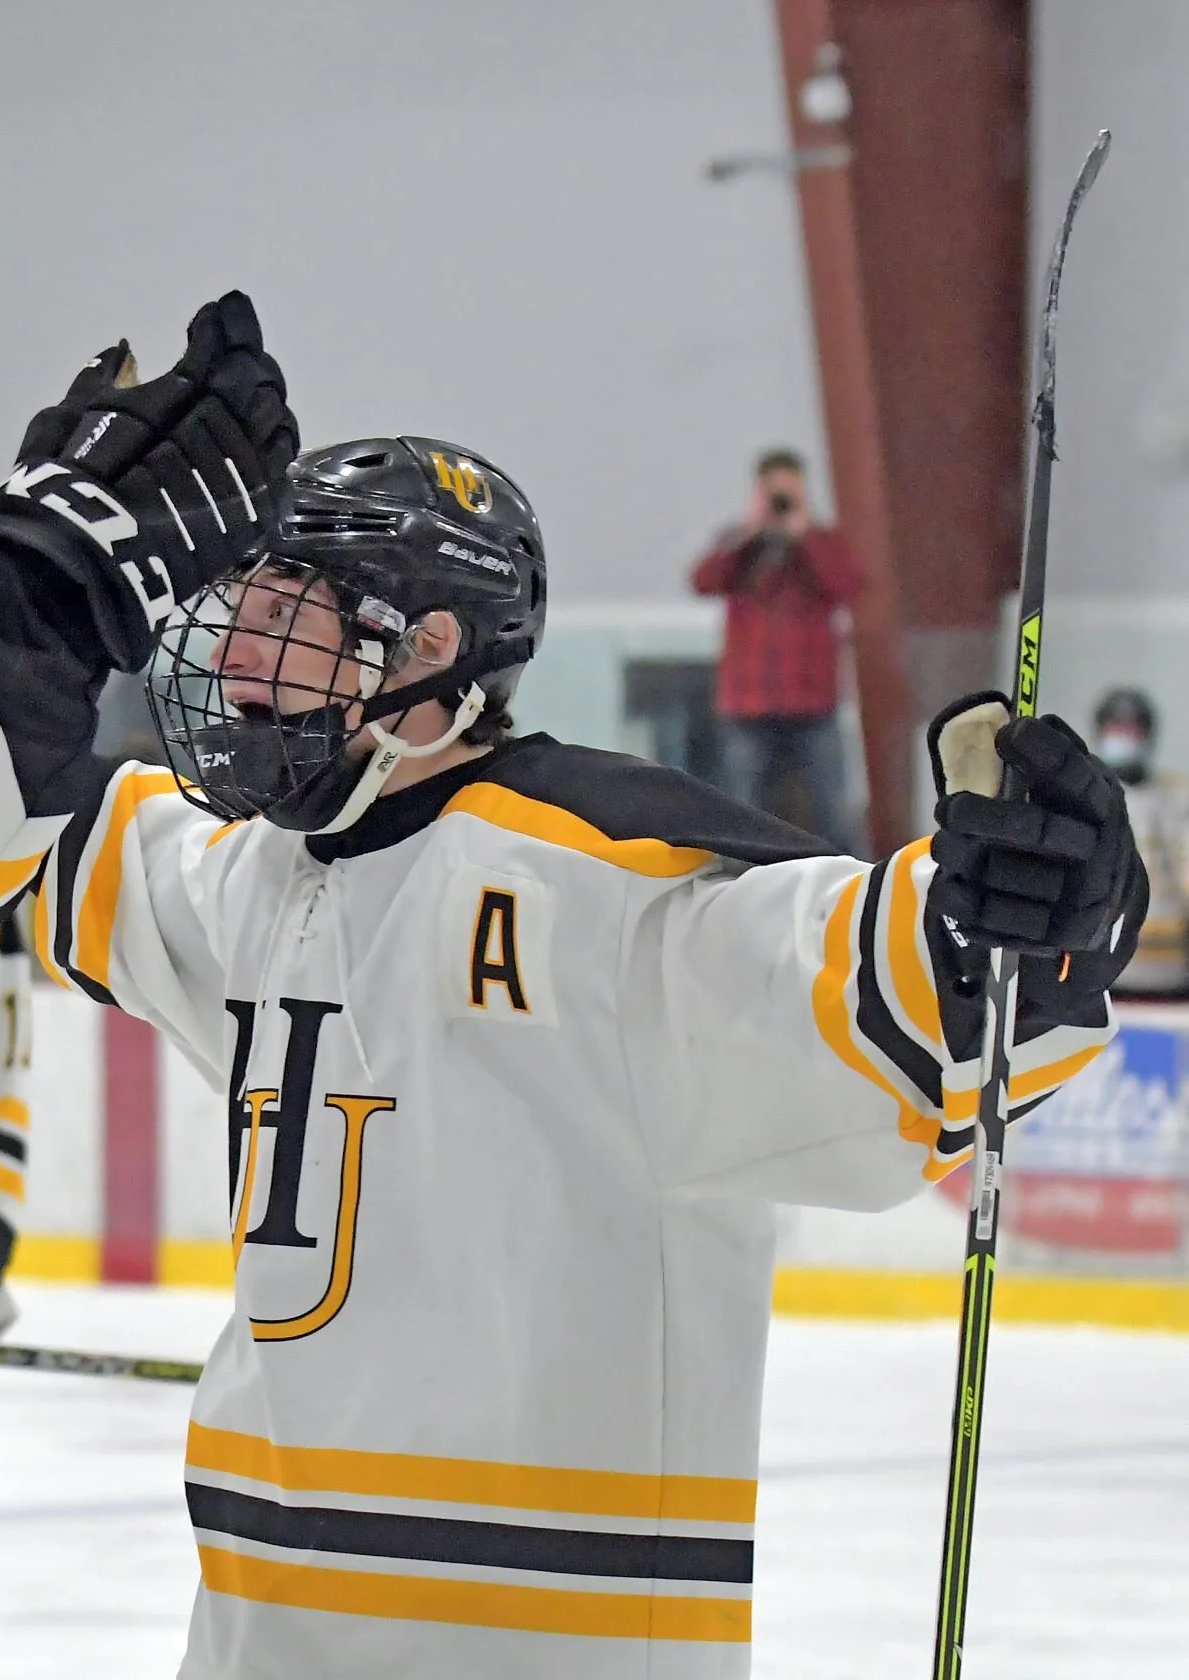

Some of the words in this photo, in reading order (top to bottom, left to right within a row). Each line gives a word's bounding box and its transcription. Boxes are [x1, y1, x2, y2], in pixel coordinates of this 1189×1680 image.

[438, 541, 513, 577] BAUER
[1016, 632, 1038, 719] CM
[196, 751, 232, 769] CM
[468, 886, 532, 1014] A
